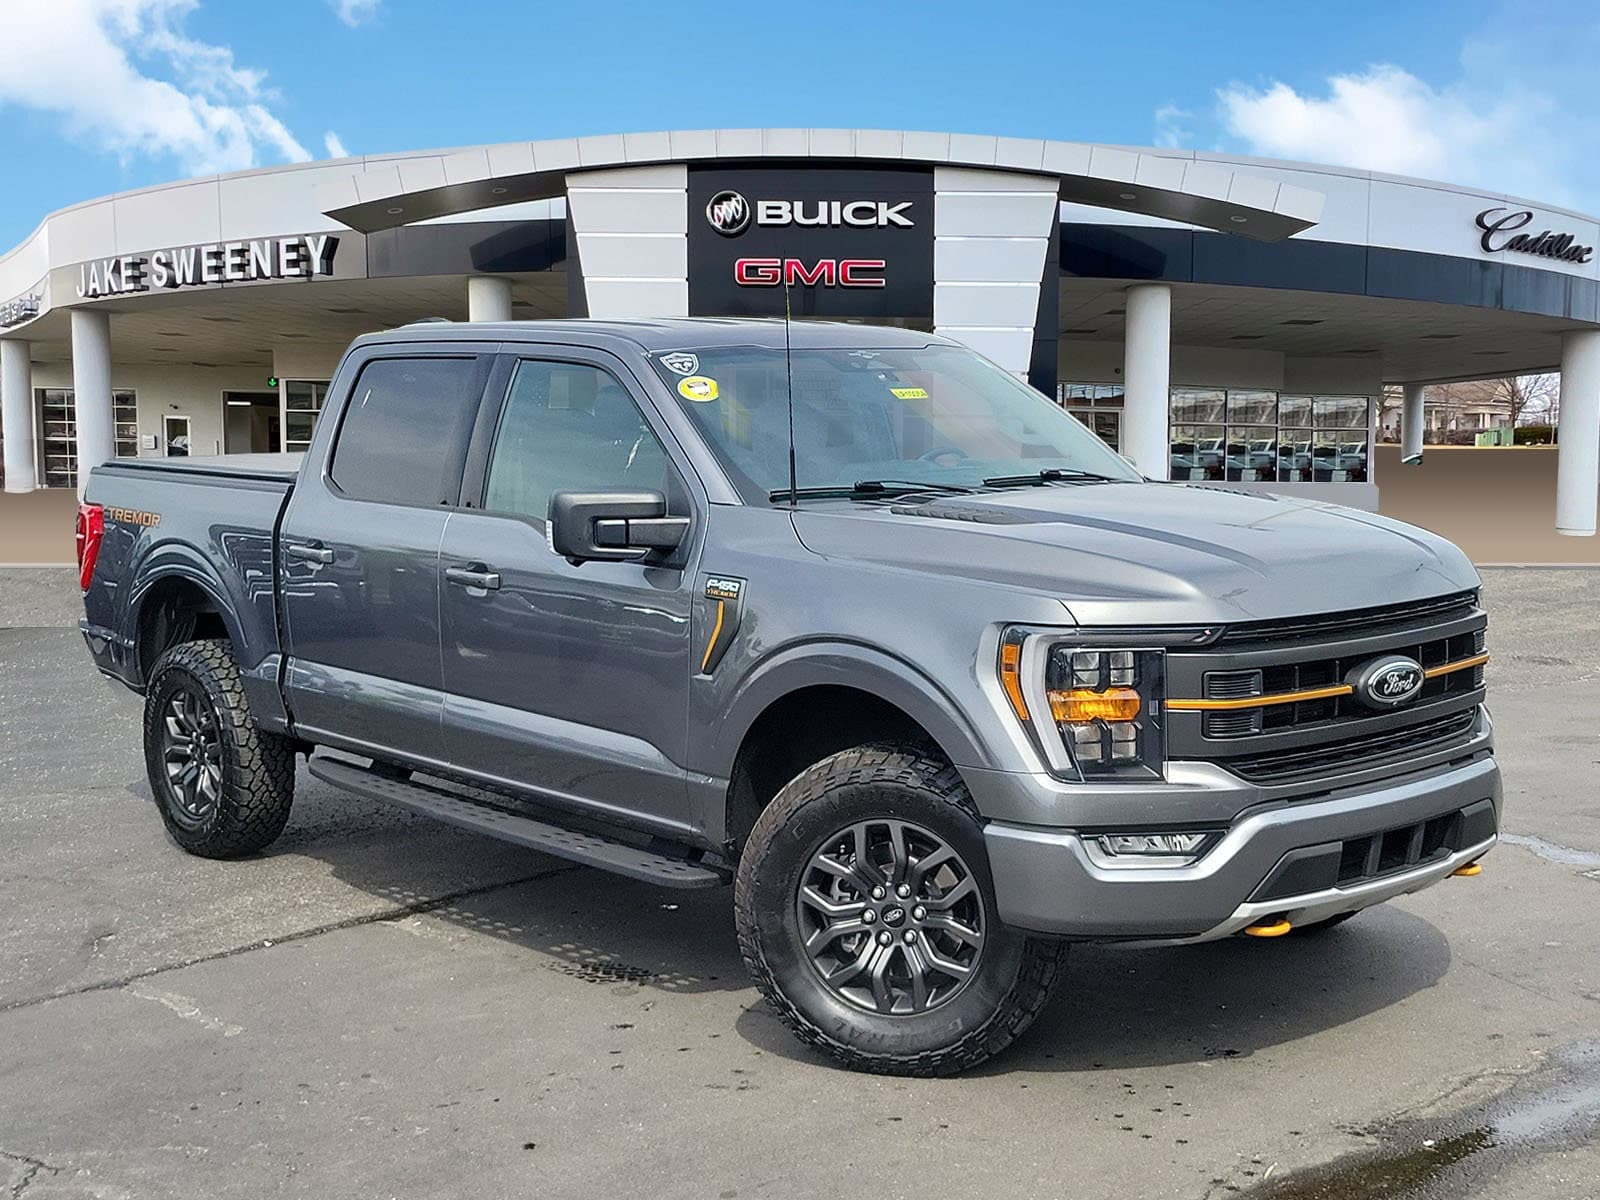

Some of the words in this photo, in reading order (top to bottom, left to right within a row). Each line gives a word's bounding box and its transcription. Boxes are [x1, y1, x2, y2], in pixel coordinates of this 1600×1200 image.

[757, 200, 915, 226] BUICK
[1475, 207, 1593, 263] Cadillac
[76, 256, 146, 298] JAKE
[152, 235, 335, 288] SWEENEY
[735, 258, 886, 287] GMC
[108, 507, 161, 527] TREMOR
[1384, 669, 1414, 695] Ford
